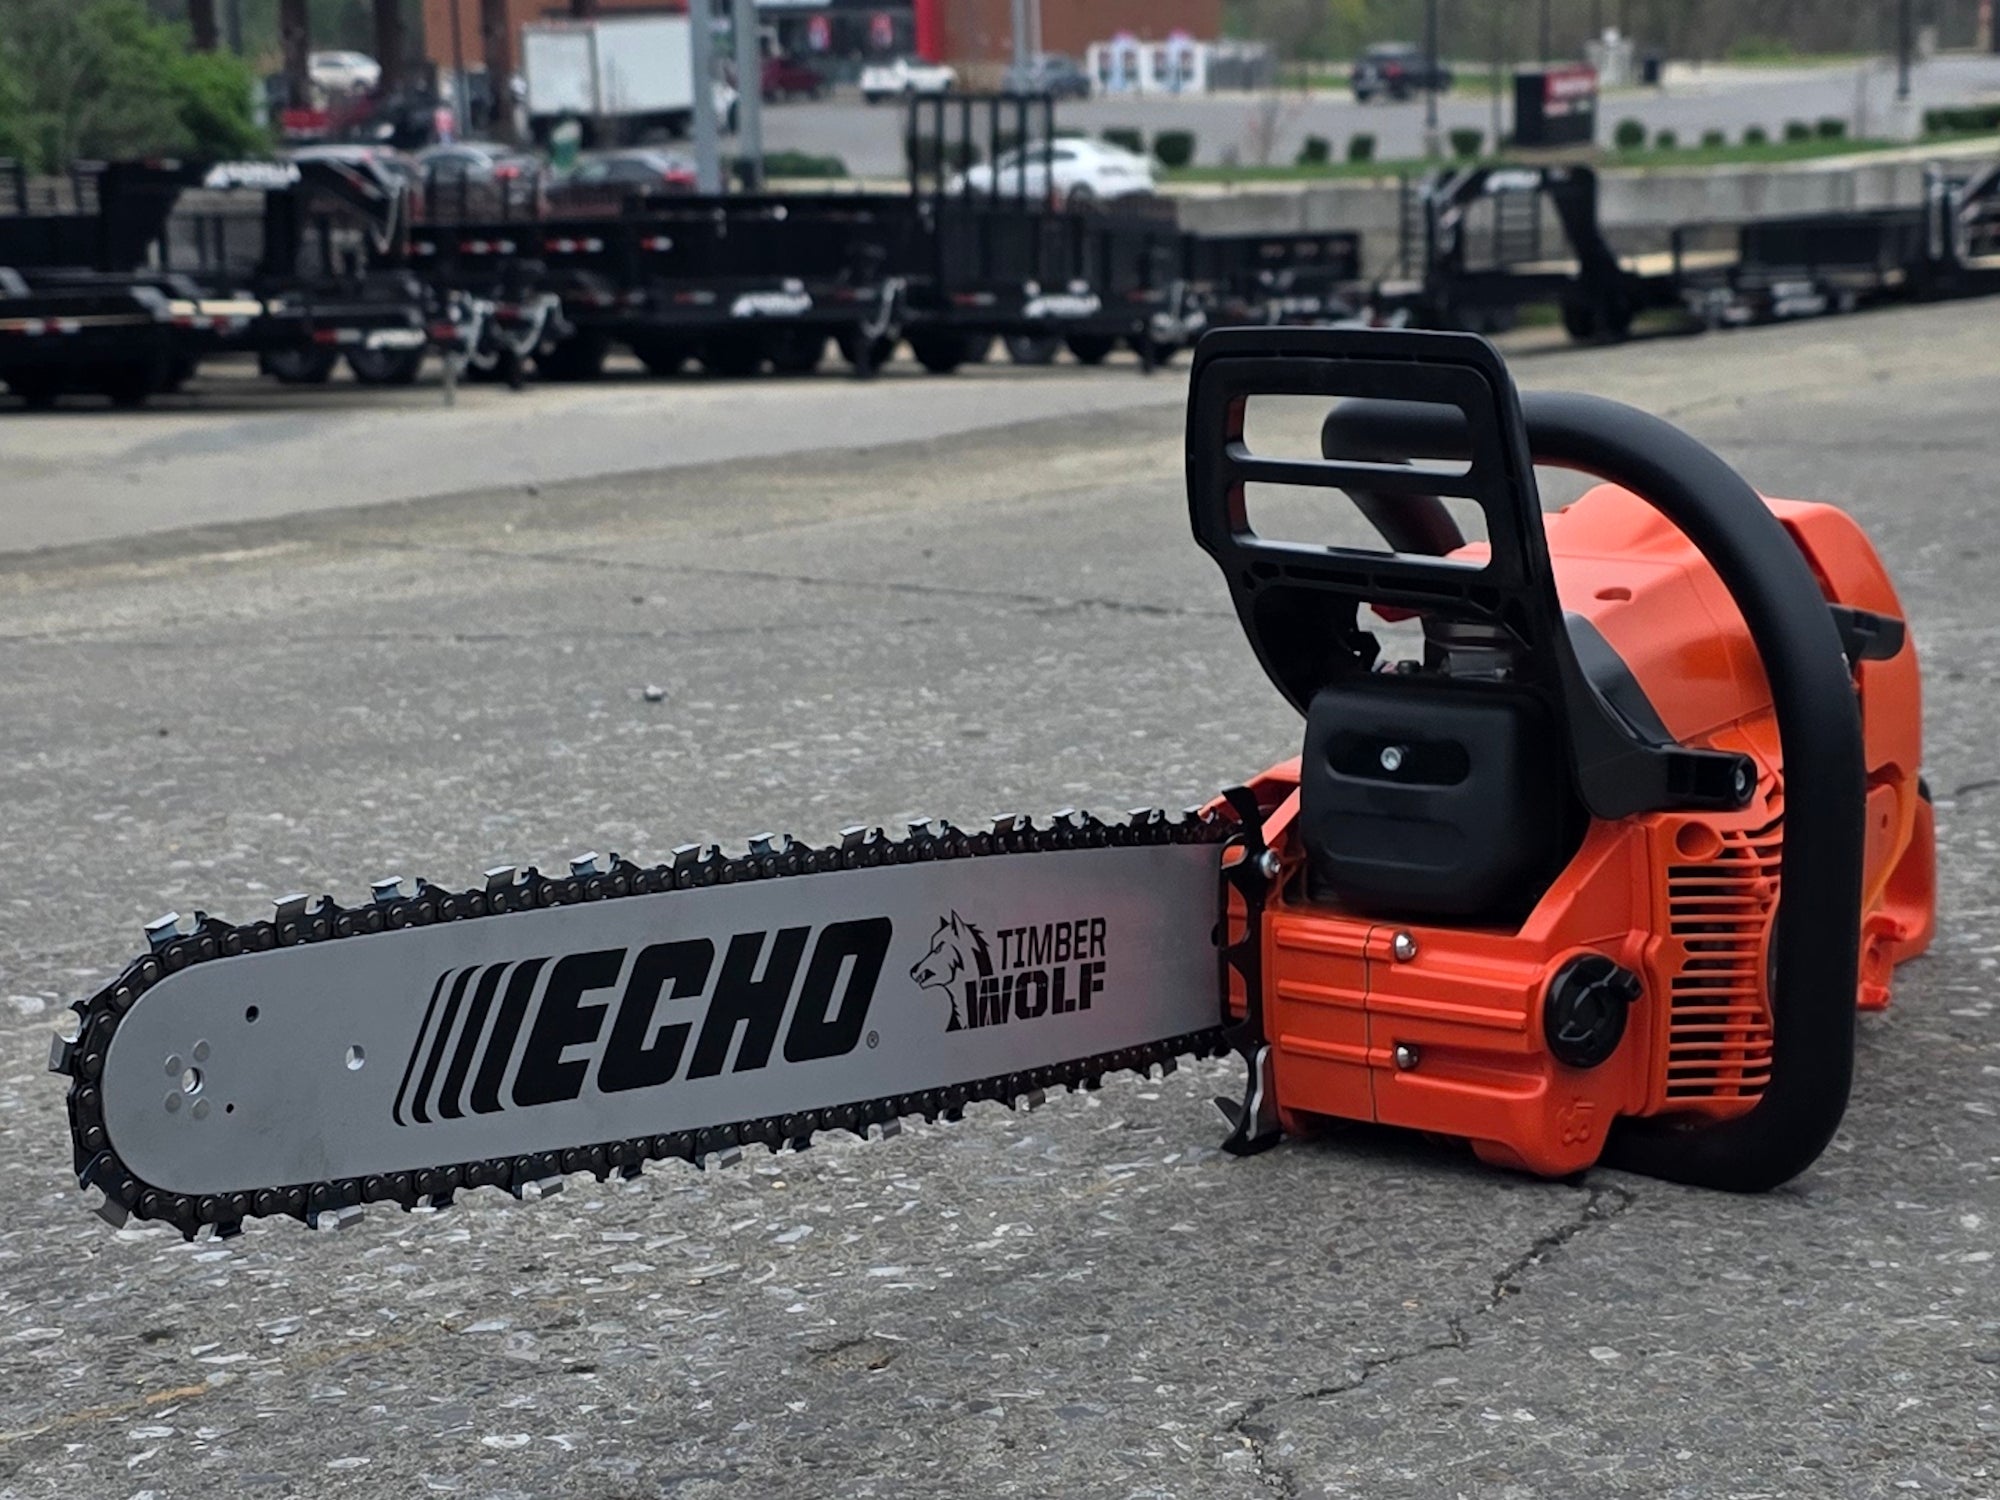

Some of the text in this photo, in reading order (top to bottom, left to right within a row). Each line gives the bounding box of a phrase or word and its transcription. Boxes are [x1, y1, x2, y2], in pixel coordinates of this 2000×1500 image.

[996, 916, 1107, 971] TIMBER
[511, 916, 893, 1108] ECHO
[964, 960, 1107, 1030] WOLF
